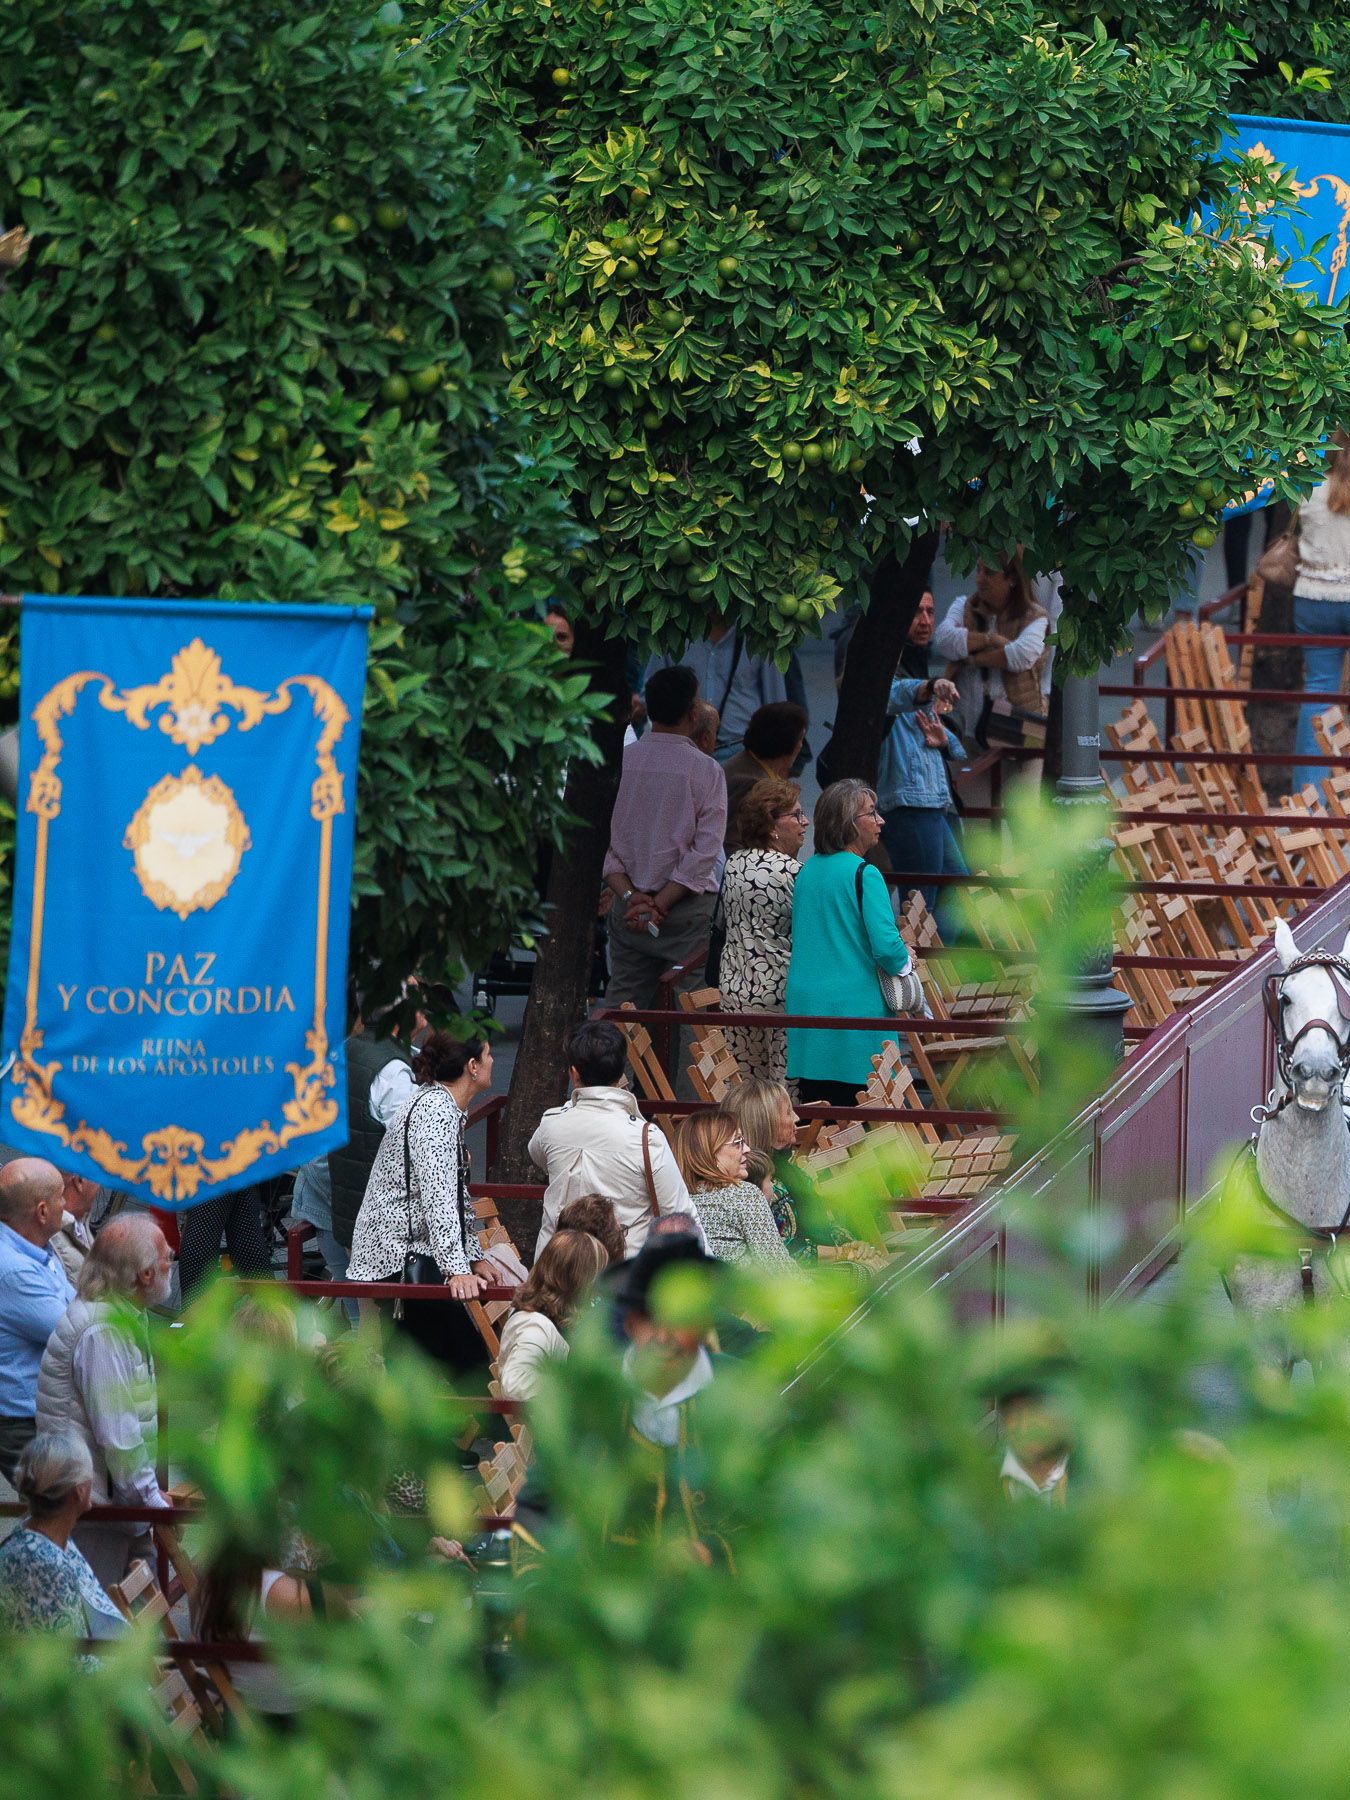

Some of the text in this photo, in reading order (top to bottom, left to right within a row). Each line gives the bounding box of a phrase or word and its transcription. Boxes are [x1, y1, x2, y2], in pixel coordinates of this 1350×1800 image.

[144, 951, 218, 986] PAZ
[56, 983, 297, 1017] Y CONCORDIA
[141, 1038, 207, 1057] REINA
[71, 1055, 99, 1075] DE
[108, 1056, 147, 1076] LOS
